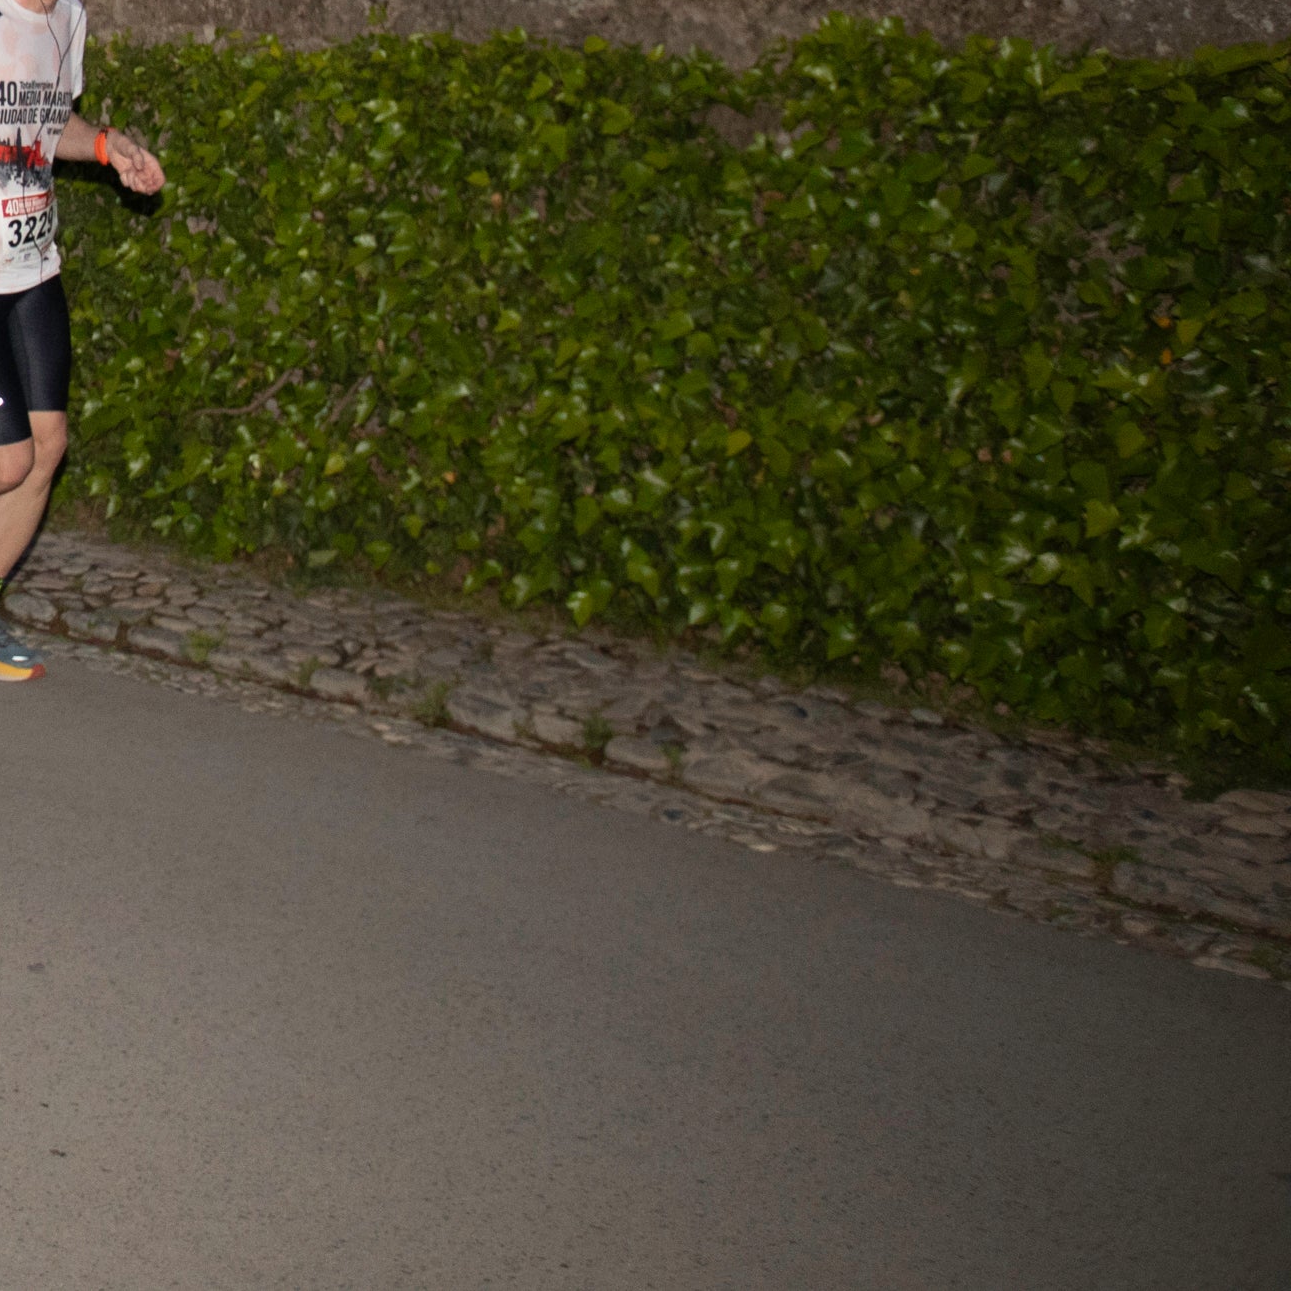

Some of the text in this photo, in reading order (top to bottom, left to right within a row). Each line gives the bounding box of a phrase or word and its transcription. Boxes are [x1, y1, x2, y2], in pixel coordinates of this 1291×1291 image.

[39, 108, 70, 124] GRANA
[5, 198, 19, 217] 40
[8, 205, 54, 248] 3229
